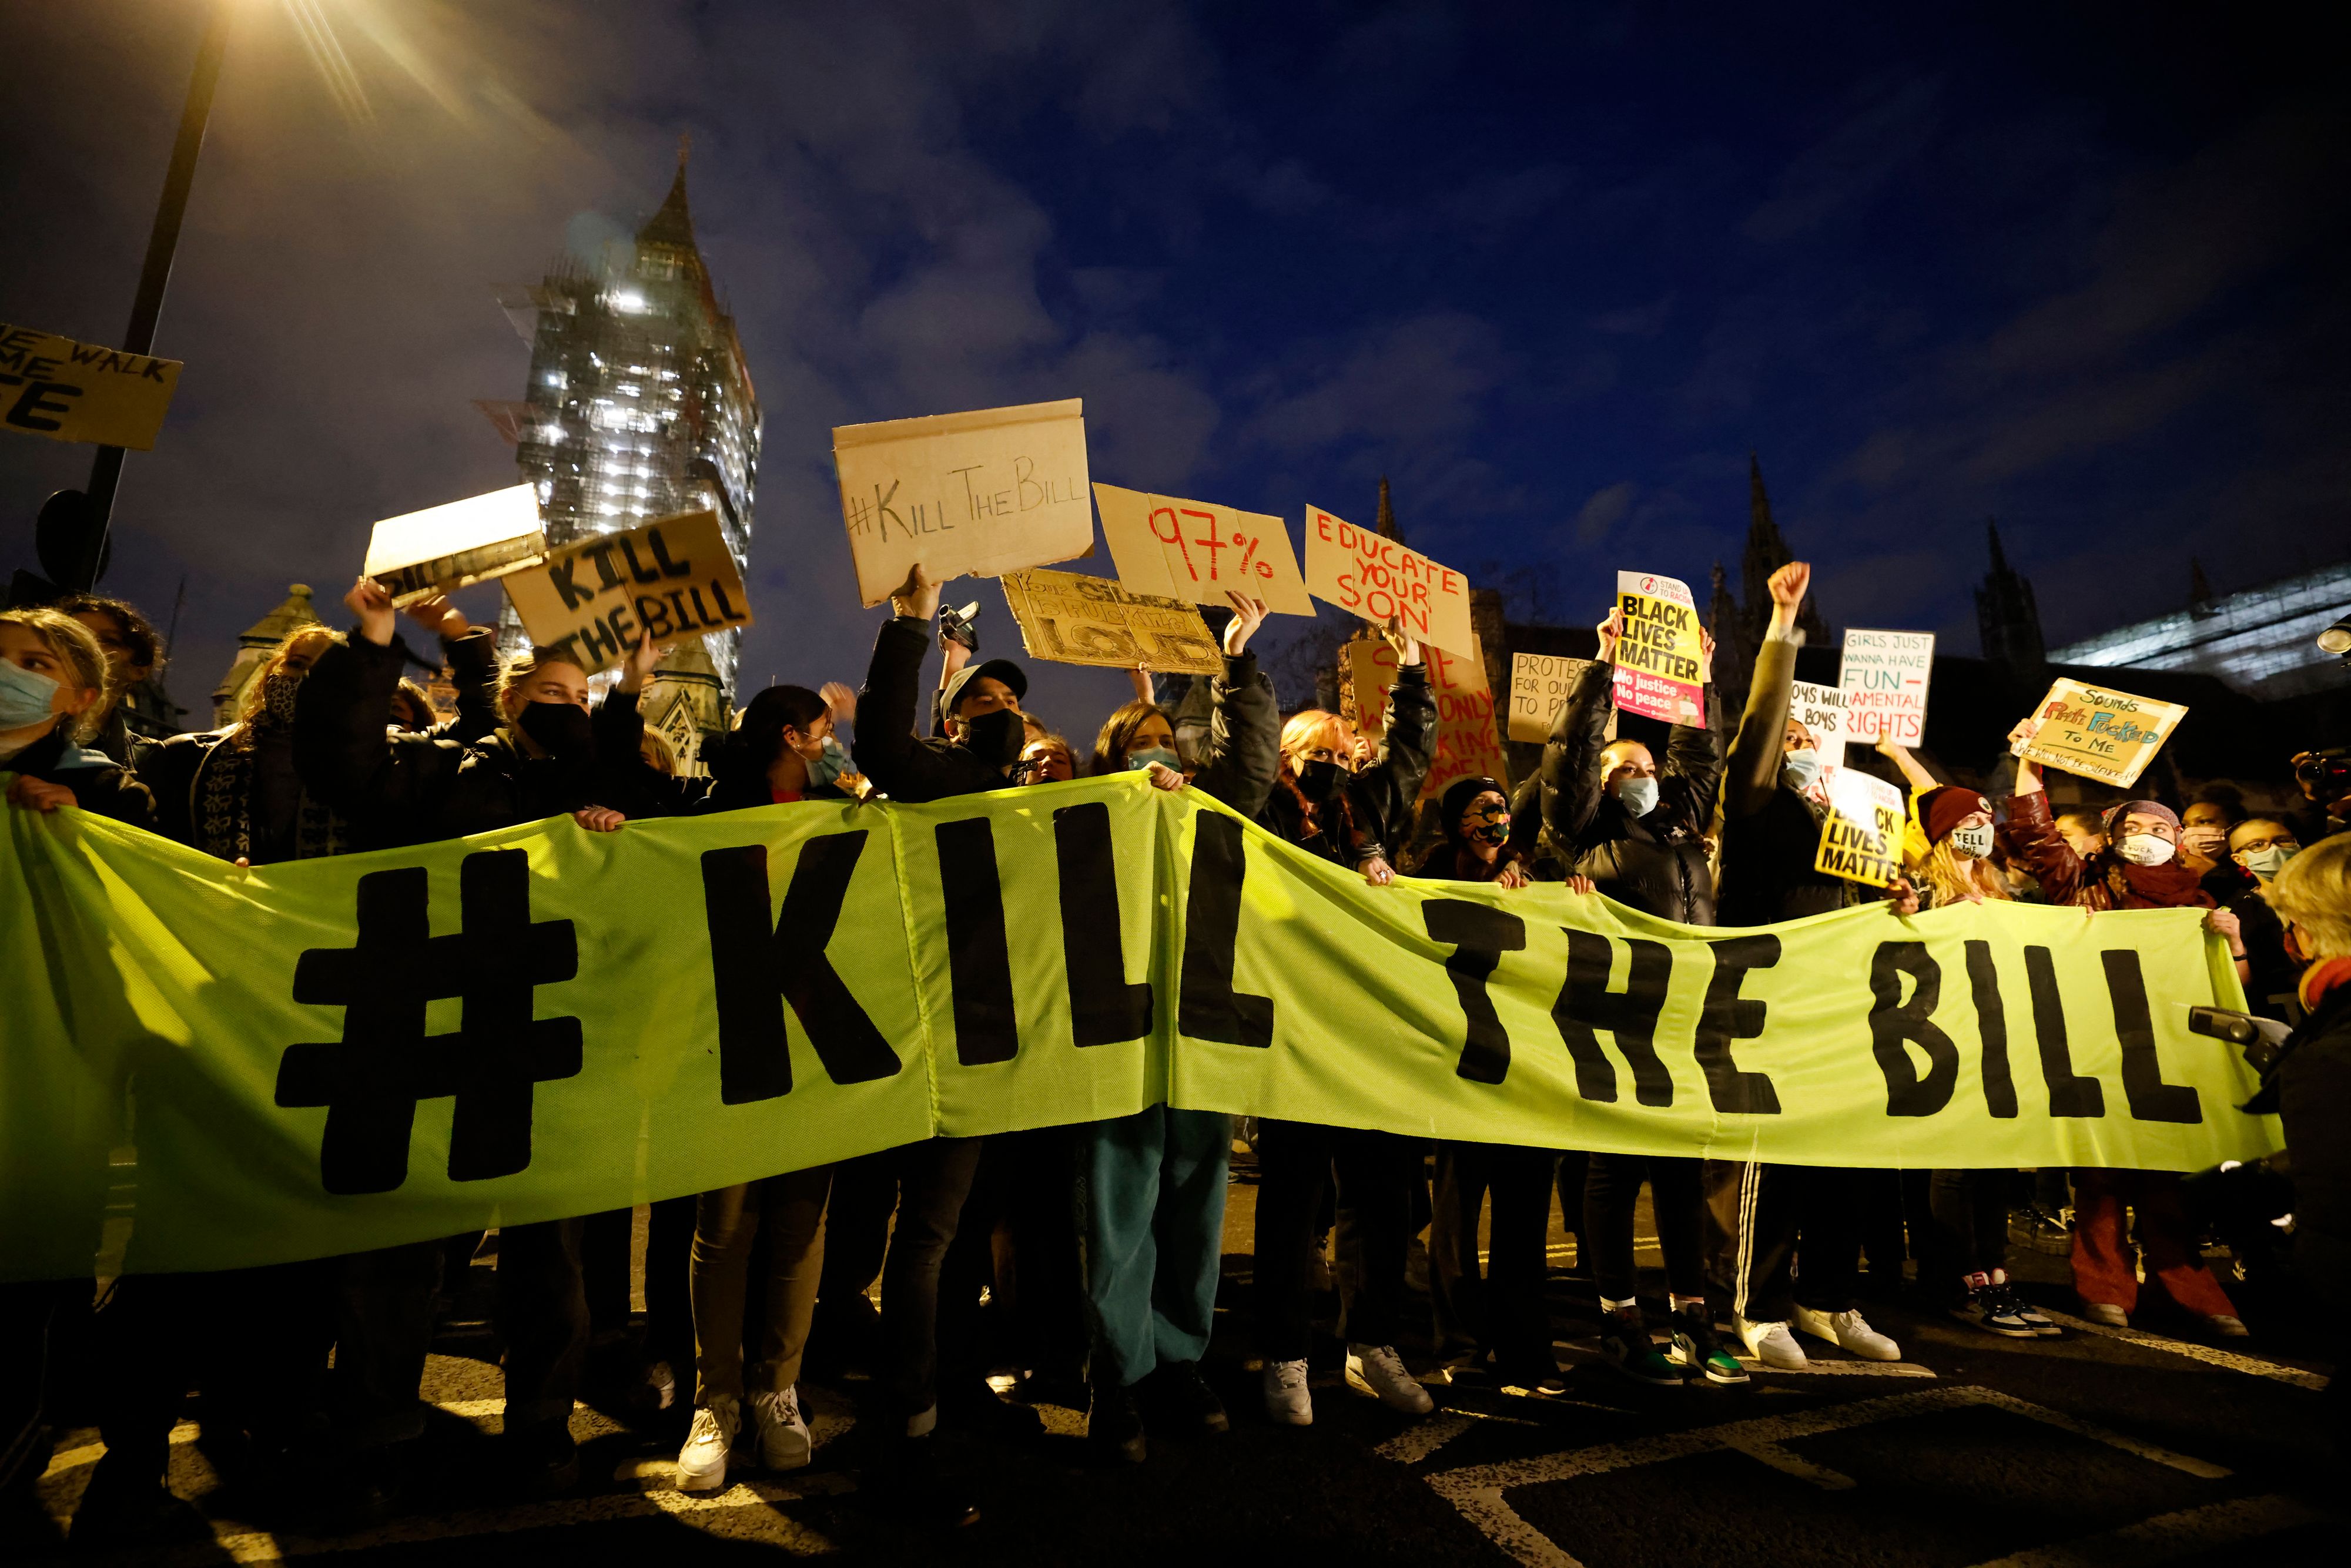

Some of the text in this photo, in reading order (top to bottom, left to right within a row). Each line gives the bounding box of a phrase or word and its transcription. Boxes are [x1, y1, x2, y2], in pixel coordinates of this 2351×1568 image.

[0, 325, 169, 383] E WALK
[0, 374, 83, 431] E
[1148, 507, 1274, 582] 97%
[1317, 514, 1459, 595] EDUCATE
[548, 527, 691, 611] KILL
[1356, 558, 1432, 614] YOUR
[1660, 581, 1681, 592] STAND
[1660, 588, 1691, 604] TO RACISM
[1337, 574, 1428, 635] SON
[1622, 595, 1690, 631] BLACK
[550, 579, 746, 664] THE BILL
[1621, 617, 1677, 651] LIVES
[1036, 617, 1222, 666] LOUD
[1846, 634, 1931, 650] GIRLS JUST
[1517, 655, 1591, 679] PROTES
[1619, 639, 1699, 682] MATTER
[1843, 653, 1925, 668] WANNA HAVE
[1515, 677, 1539, 693] FOR
[1616, 668, 1677, 697] No justice
[1616, 684, 1633, 700] No
[1635, 691, 1672, 710] peace
[1791, 684, 1848, 708] OYS WILL
[1439, 686, 1493, 733] ONLY
[1515, 696, 1538, 715] TO
[1849, 692, 1924, 710] AMENTAL
[1804, 708, 1837, 732] BOYS
[1847, 711, 1921, 738] RIGHTS
[2018, 743, 2033, 755] WE
[1827, 823, 1888, 855] LIVES
[1954, 832, 1984, 845] TELL
[2128, 845, 2153, 853] FUCK
[1822, 847, 1897, 883] MATTE
[700, 802, 1274, 1105] KILL
[1421, 898, 1782, 1115] THE
[1868, 940, 2203, 1124] BILL
